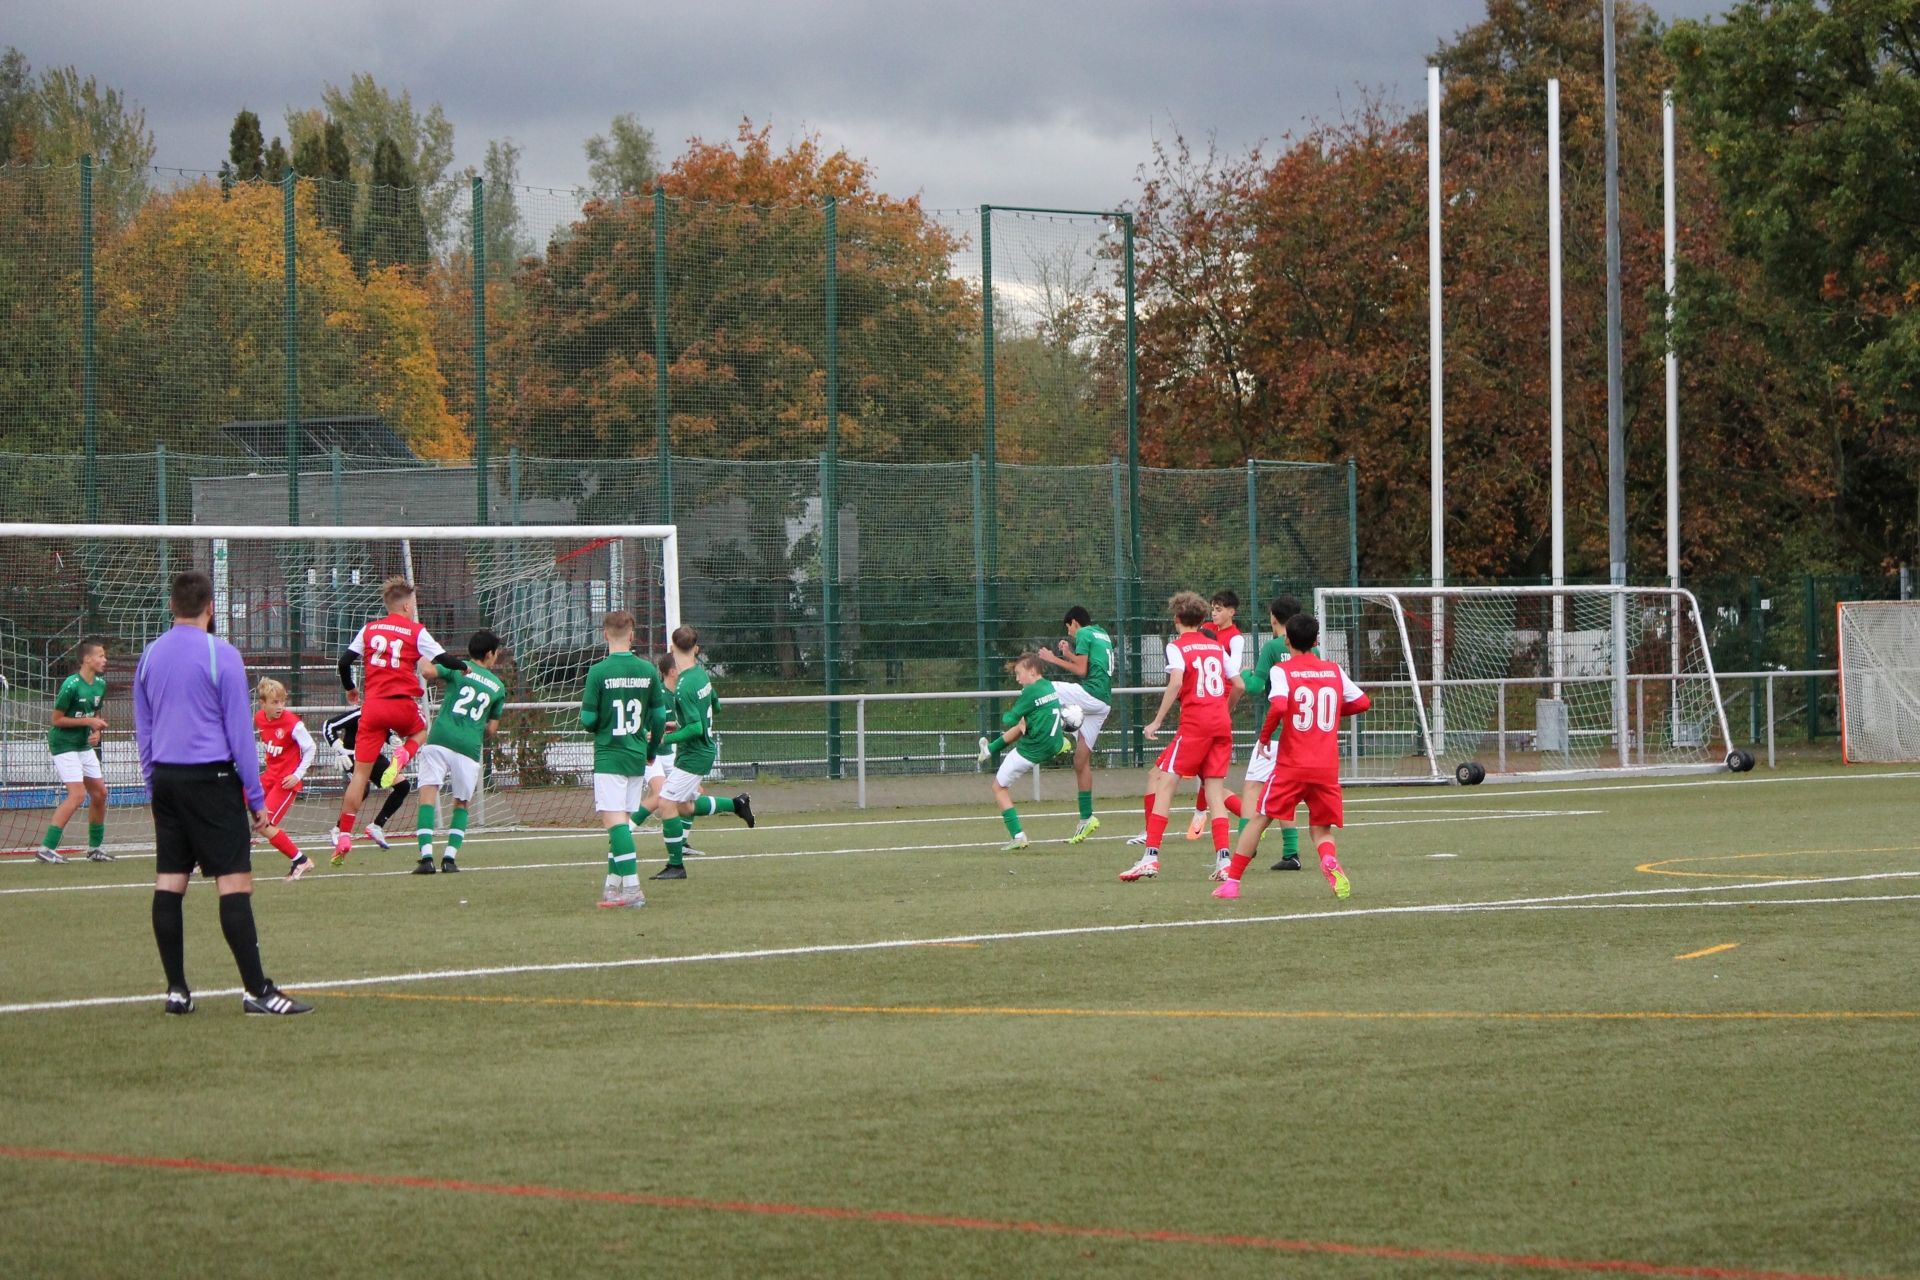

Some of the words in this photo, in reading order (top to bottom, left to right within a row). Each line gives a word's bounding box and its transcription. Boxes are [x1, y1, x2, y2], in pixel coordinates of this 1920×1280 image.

[395, 626, 412, 636] KASSEL
[370, 635, 403, 668] 21
[1207, 643, 1222, 651] KASSEL
[604, 677, 651, 689] STADTALLENDORF
[1192, 655, 1225, 697] 18
[1319, 670, 1337, 678] KASSEL
[452, 685, 490, 721] 23
[612, 698, 642, 736] 13
[1292, 686, 1338, 732] 30
[1049, 708, 1061, 737] 7
